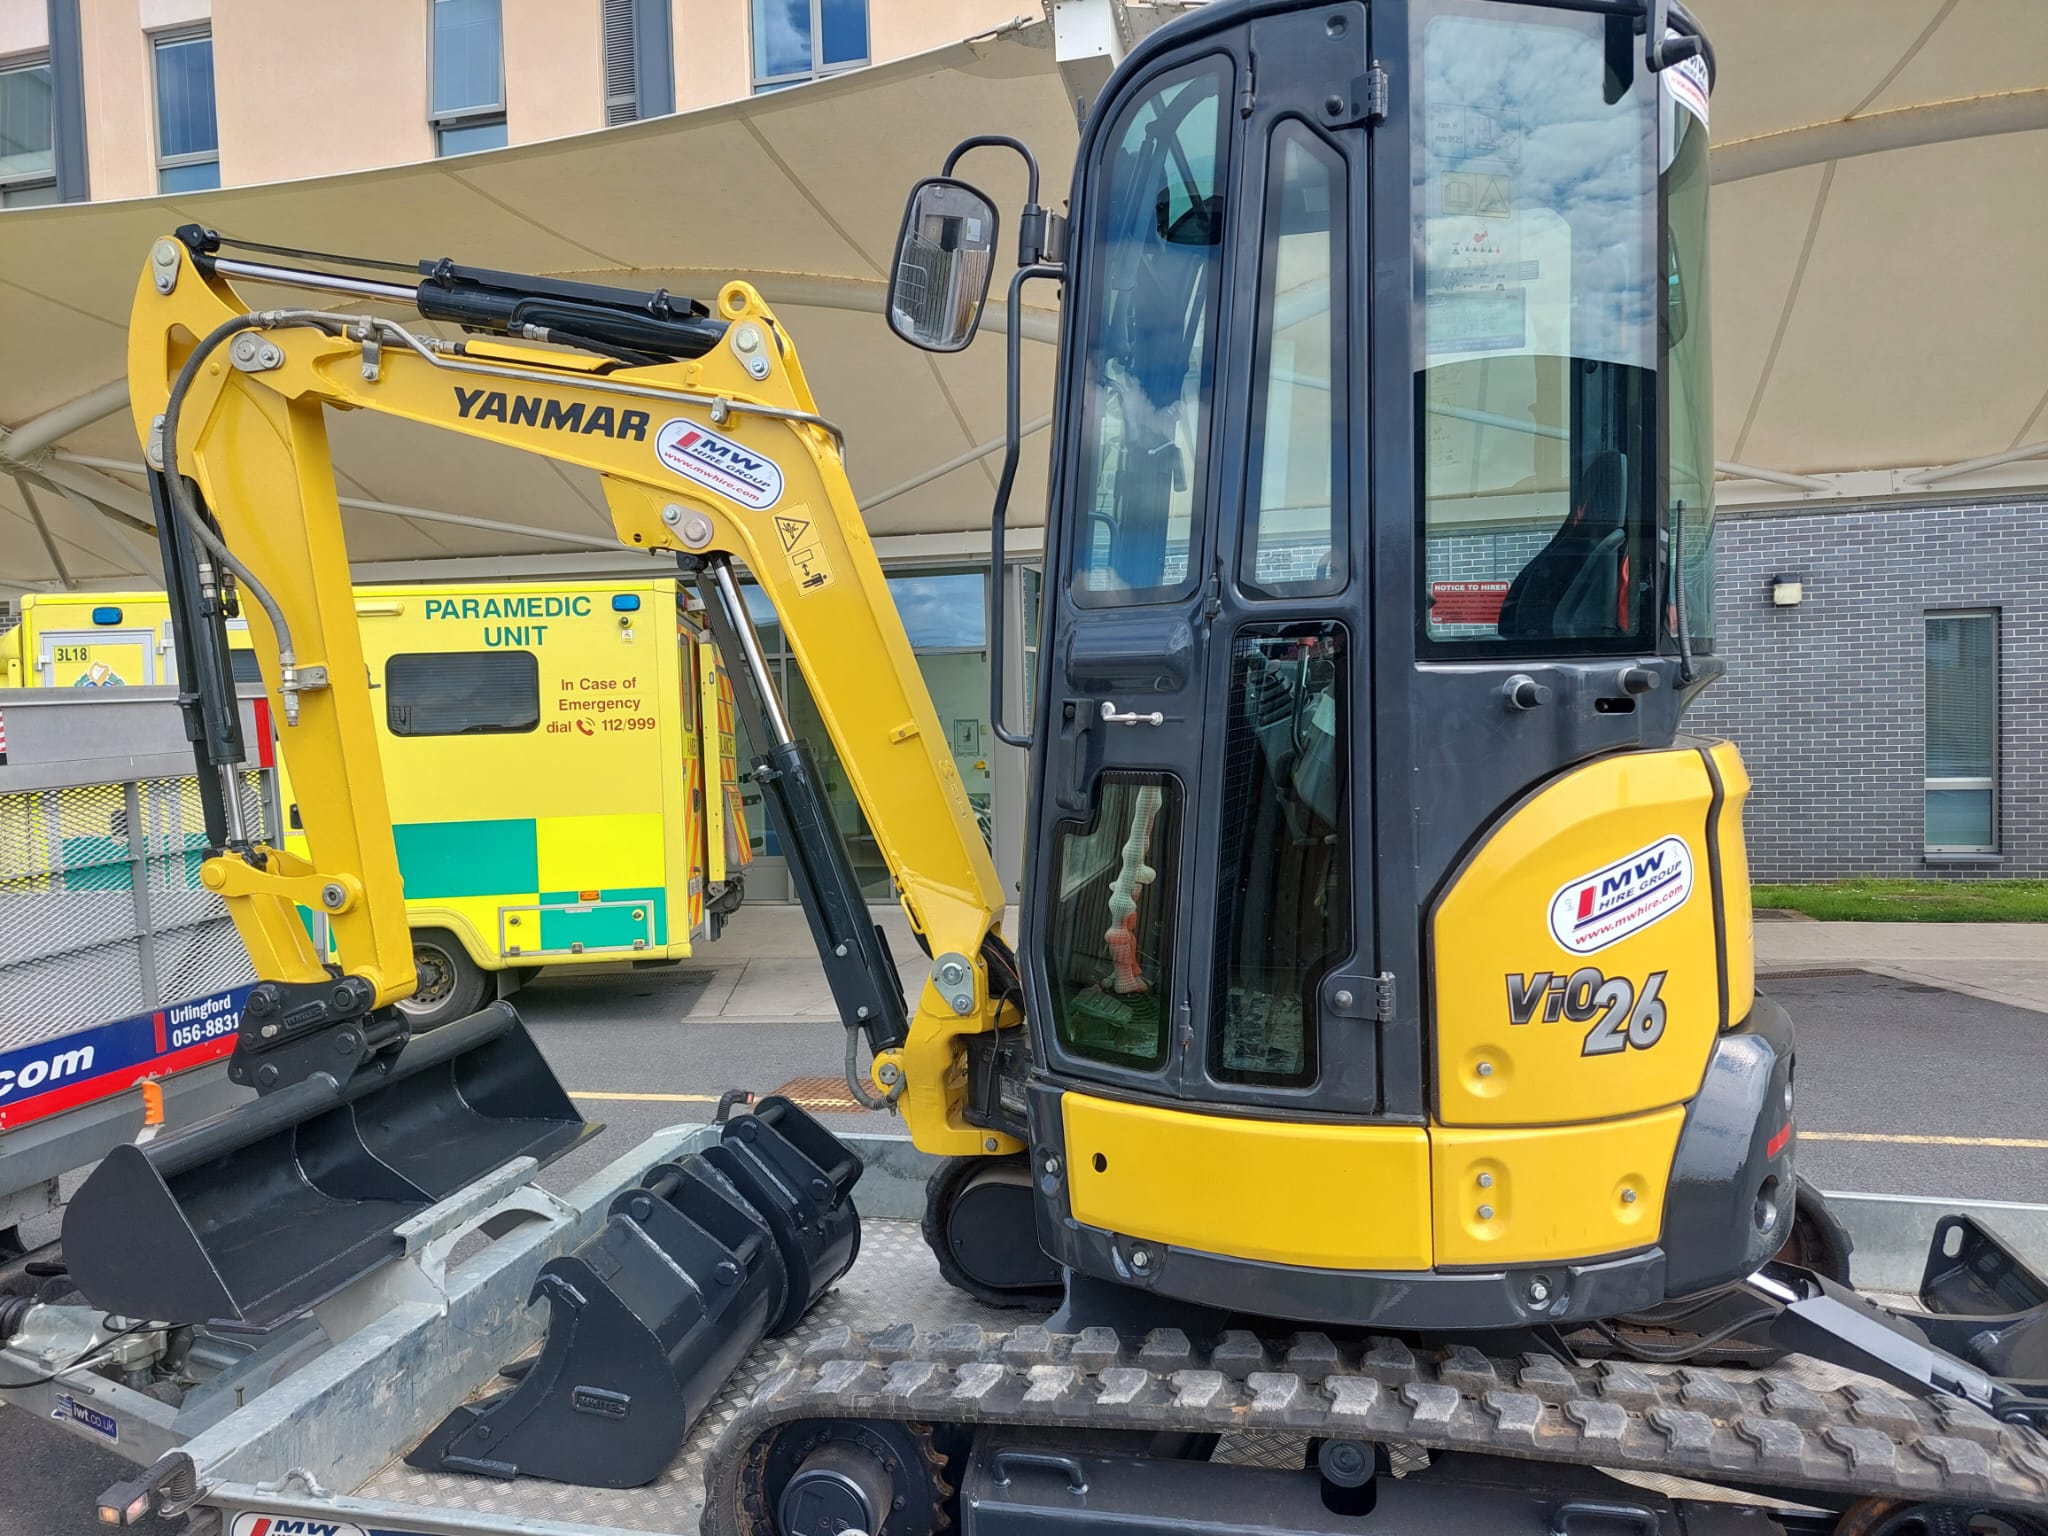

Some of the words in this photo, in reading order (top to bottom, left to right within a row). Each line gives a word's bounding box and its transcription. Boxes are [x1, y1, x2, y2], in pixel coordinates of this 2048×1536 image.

[454, 387, 650, 442] YANMAR
[691, 448, 726, 465] HIRE
[726, 464, 771, 488] GROUP
[700, 439, 763, 471] MW
[664, 451, 760, 502] www.mwhire.com
[1434, 584, 1465, 592] NOTICE
[1468, 584, 1479, 592] TO
[1480, 584, 1507, 592] HIRER
[425, 596, 591, 620] PARAMEDIC
[484, 625, 548, 648] UNIT
[57, 647, 88, 662] 3L18
[561, 678, 574, 691] In
[579, 678, 617, 690] Case
[622, 676, 637, 689] of
[558, 698, 641, 713] Emergency
[546, 720, 572, 734] dial
[601, 717, 656, 733] 112/999
[1598, 886, 1636, 911] HIRE
[1638, 860, 1682, 891] GROUP
[1601, 850, 1665, 898] MW
[1575, 884, 1683, 945] www.mwhire.com
[170, 994, 231, 1025] Urlingford
[172, 1004, 246, 1048] 056-8831
[73, 1404, 115, 1434] iwt.co.uk
[274, 1519, 341, 1536] MW
